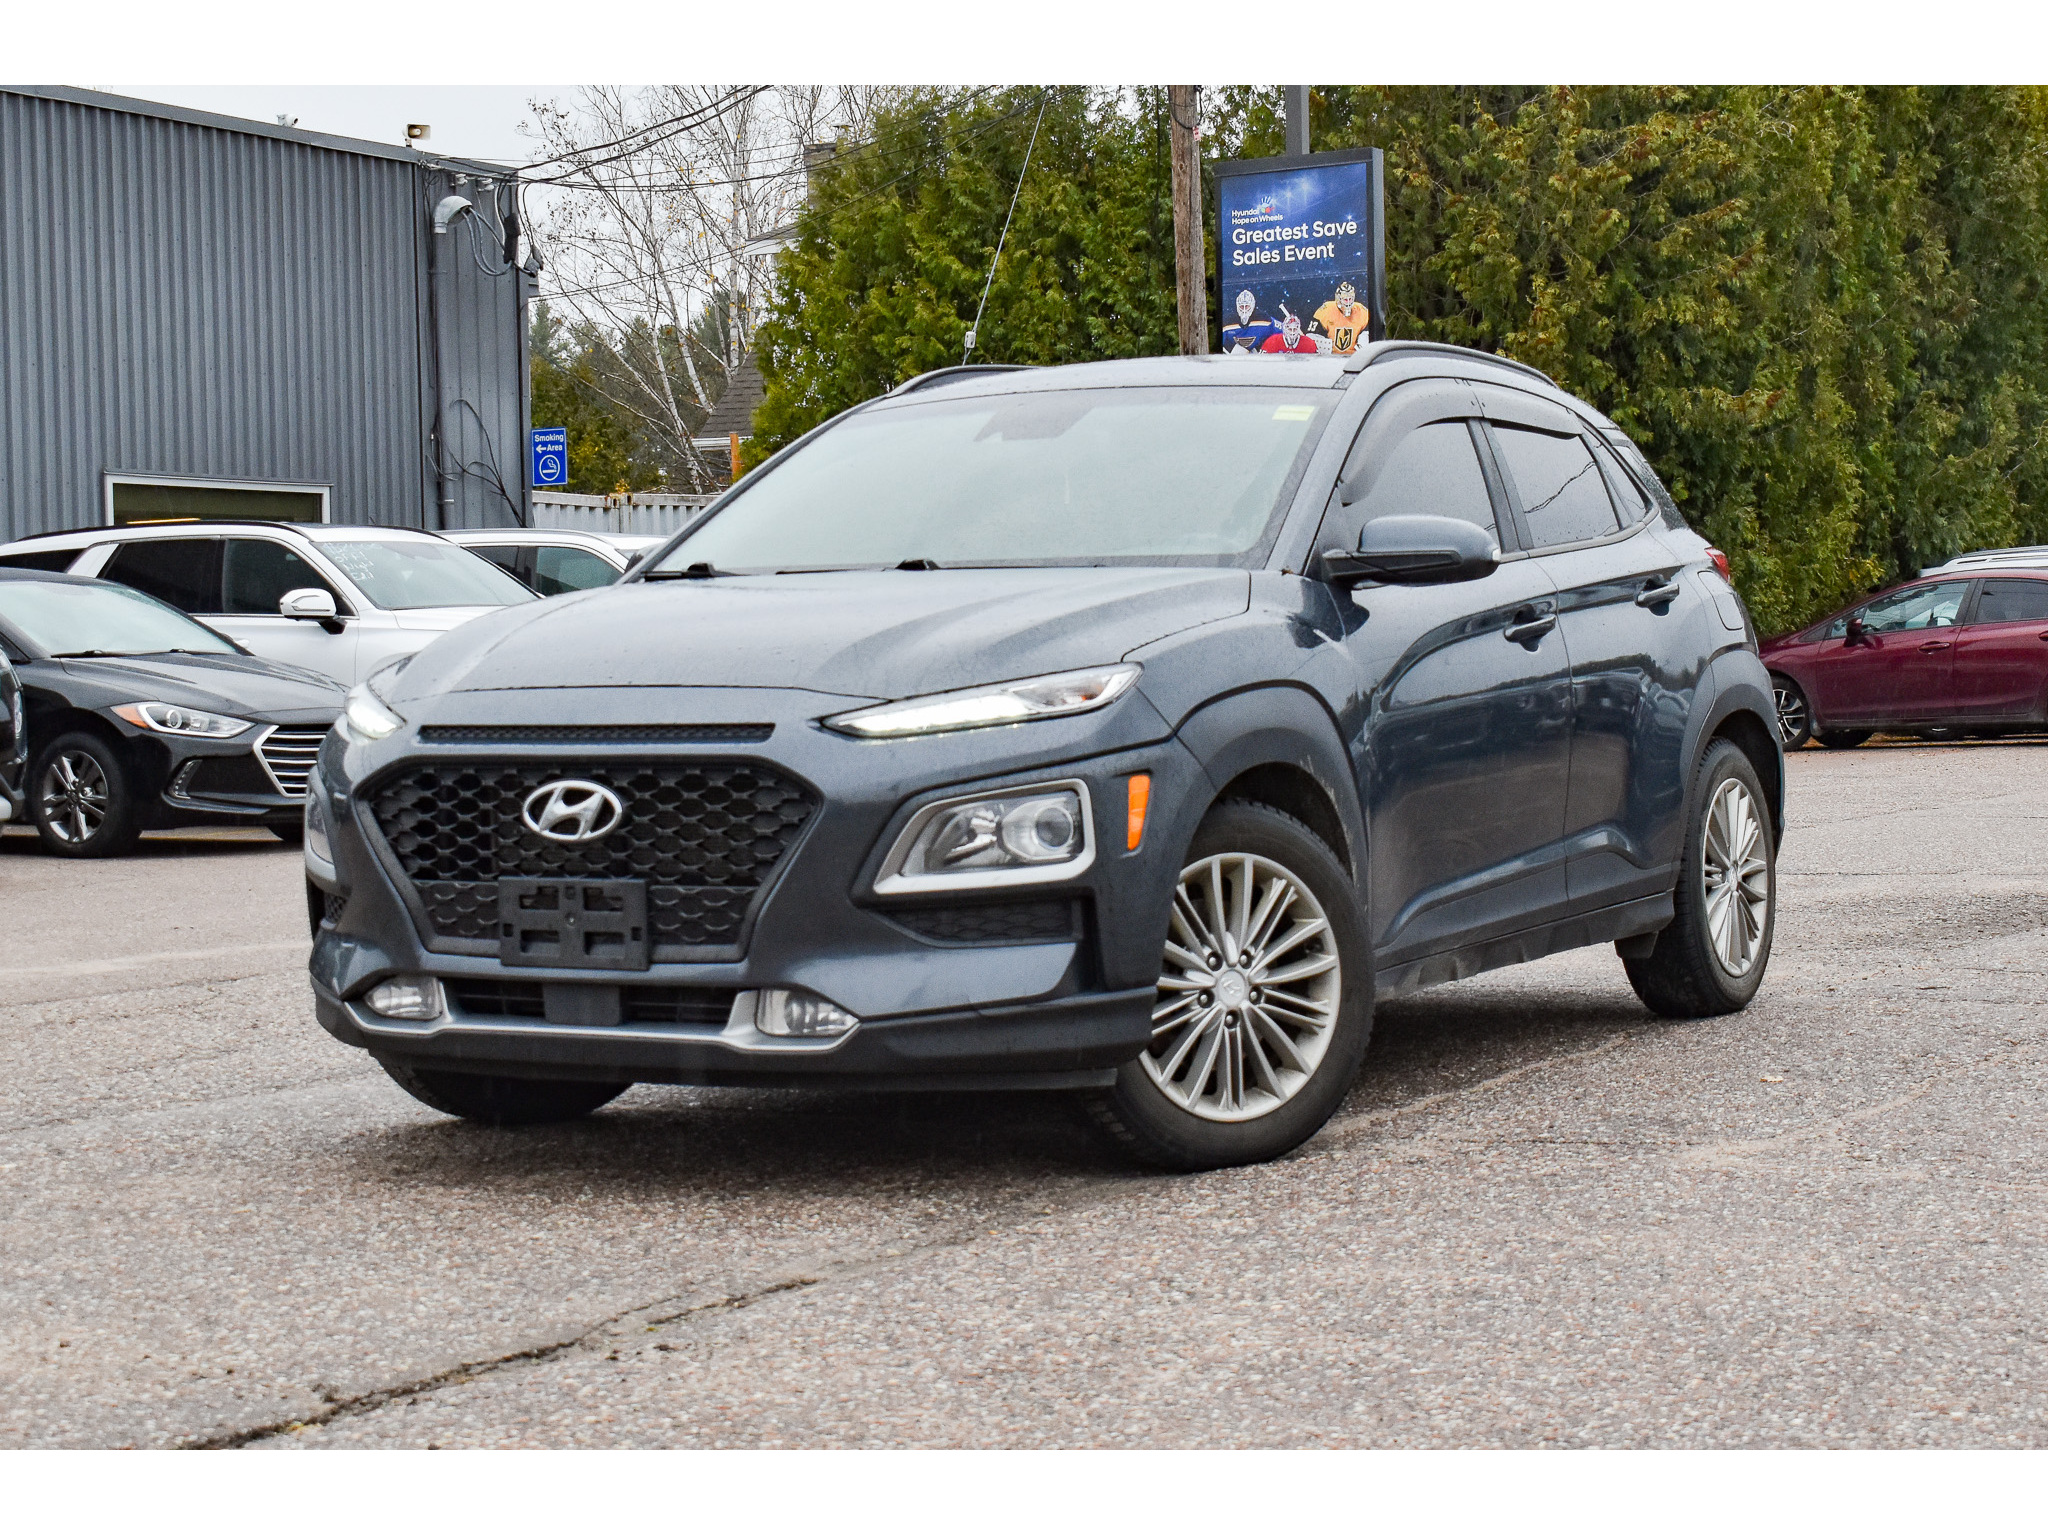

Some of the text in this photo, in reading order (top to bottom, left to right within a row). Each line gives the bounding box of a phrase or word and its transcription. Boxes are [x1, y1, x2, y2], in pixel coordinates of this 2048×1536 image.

[1232, 209, 1259, 217] Hyundai
[1259, 214, 1283, 222] Wheels
[1232, 220, 1358, 245] Greatest Save
[1232, 242, 1335, 266] Sales Event
[534, 434, 563, 442] Smoking
